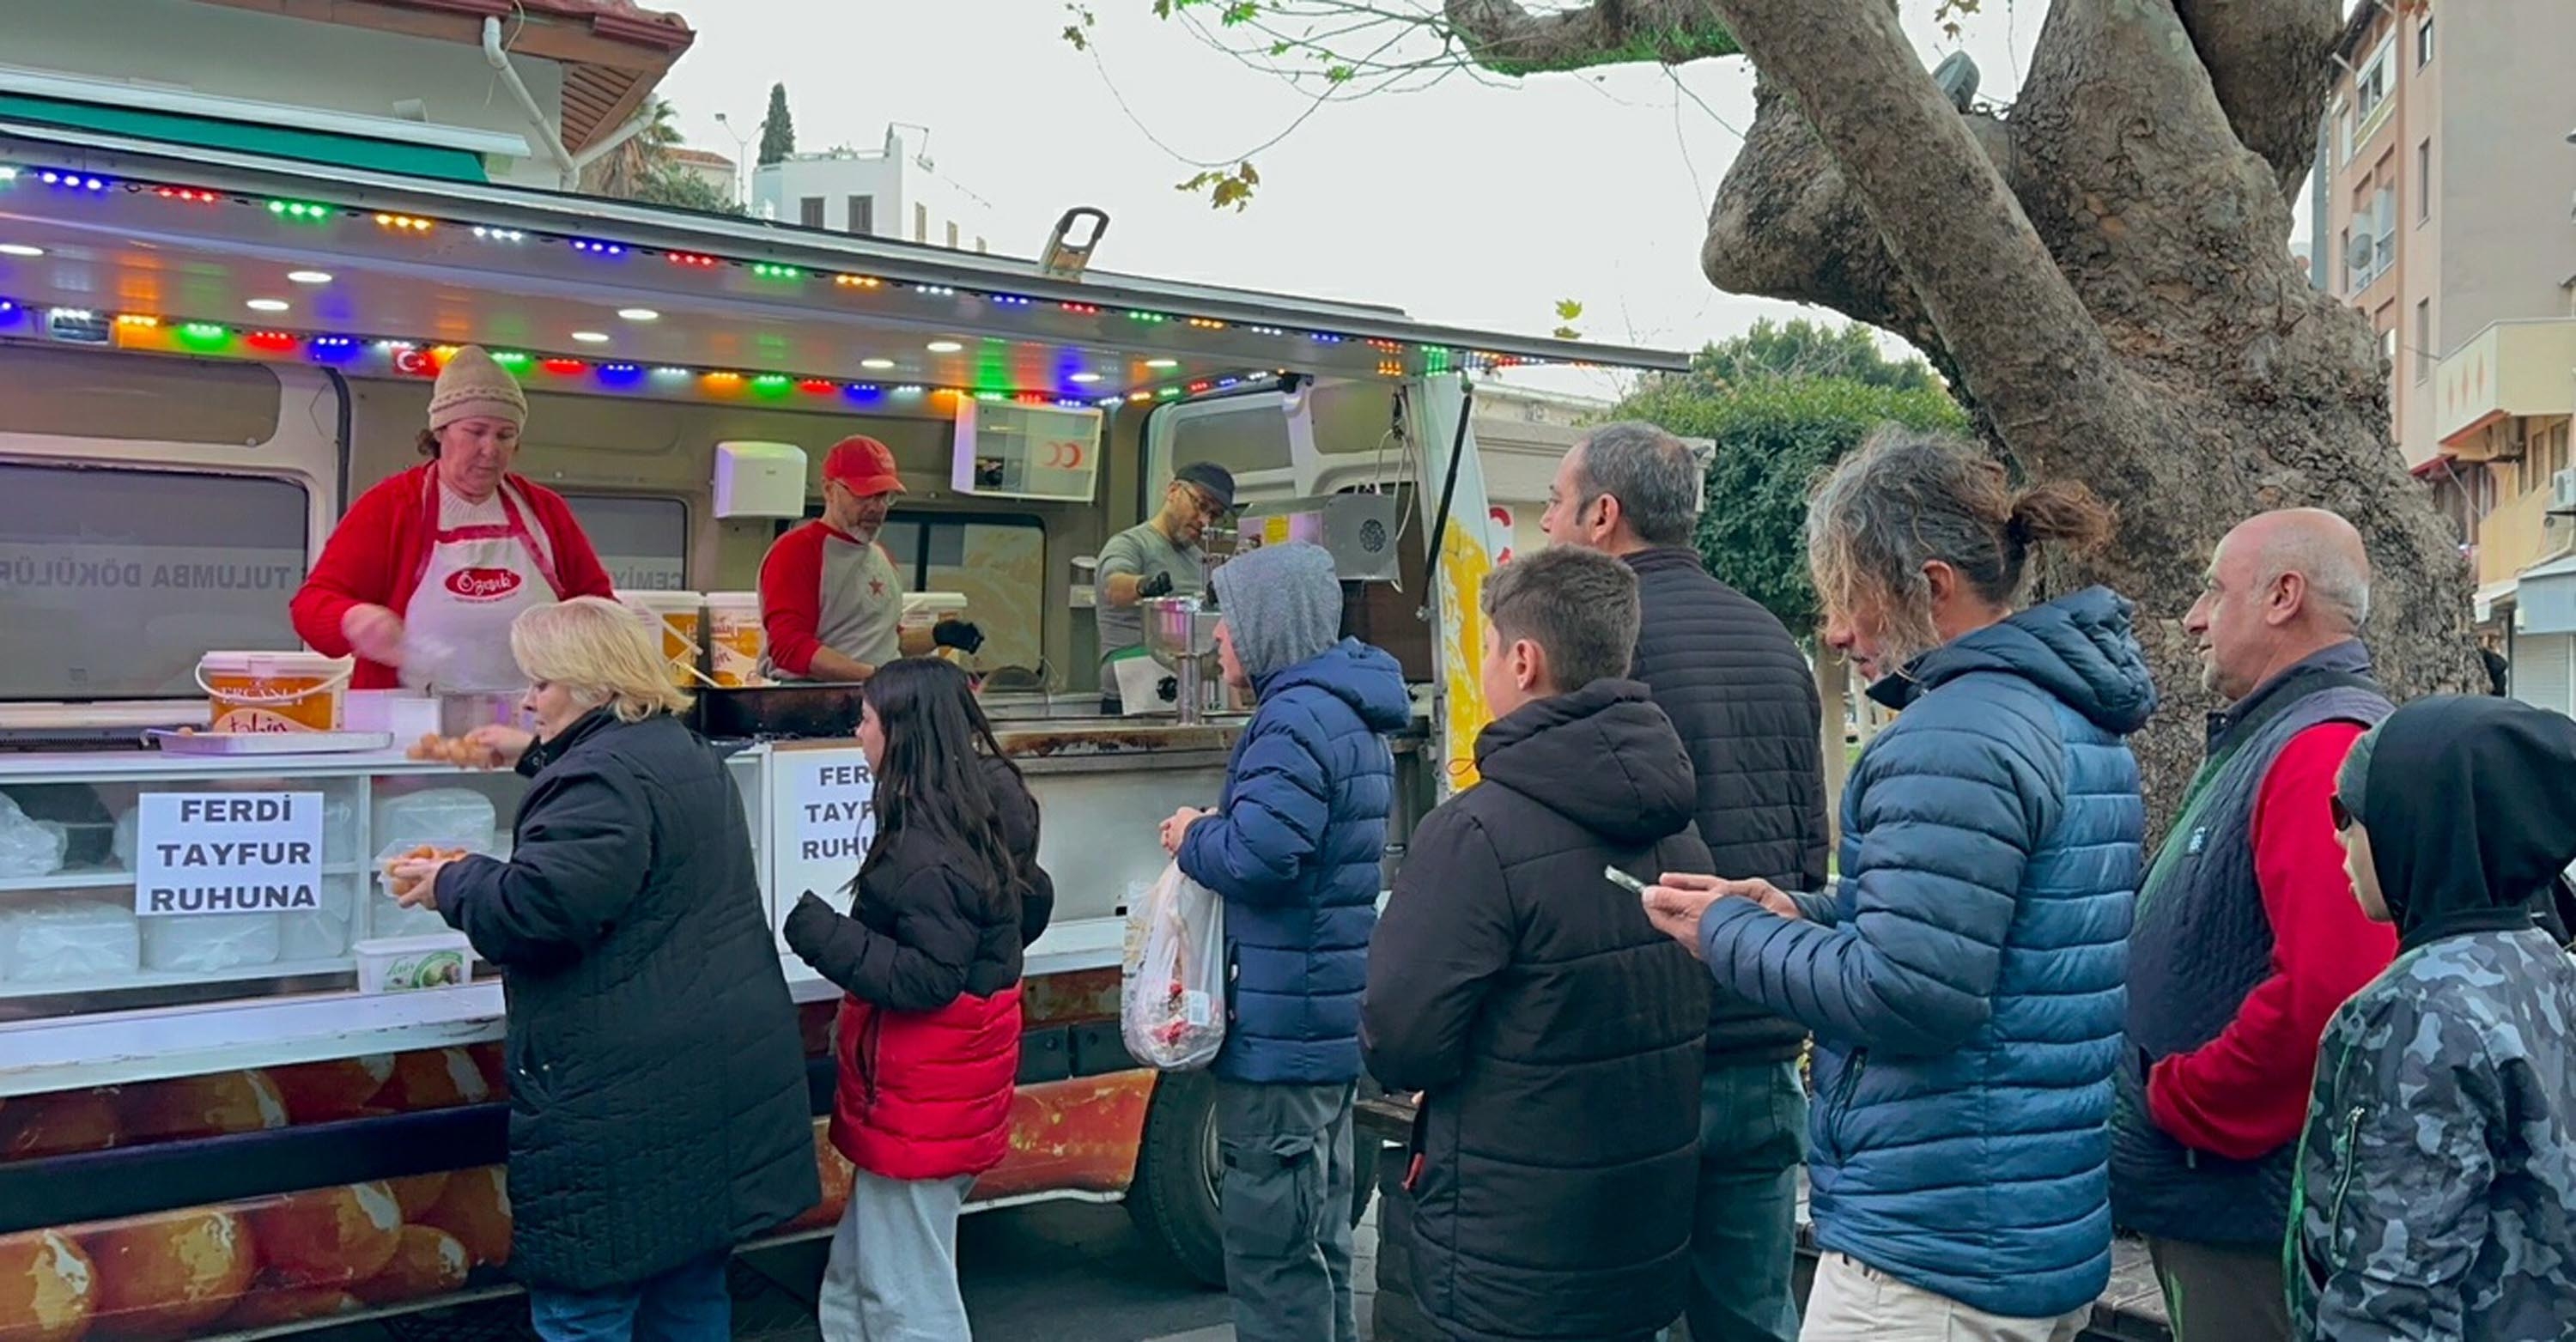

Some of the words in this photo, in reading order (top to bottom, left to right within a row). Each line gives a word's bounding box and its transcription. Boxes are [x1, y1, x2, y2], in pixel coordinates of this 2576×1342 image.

[820, 765, 871, 786] FER
[181, 794, 291, 822] FERDİ
[805, 800, 872, 823] TAYF
[156, 842, 311, 866] TAYFUR
[803, 836, 868, 859] RUH
[150, 885, 316, 911] RUHUNA
